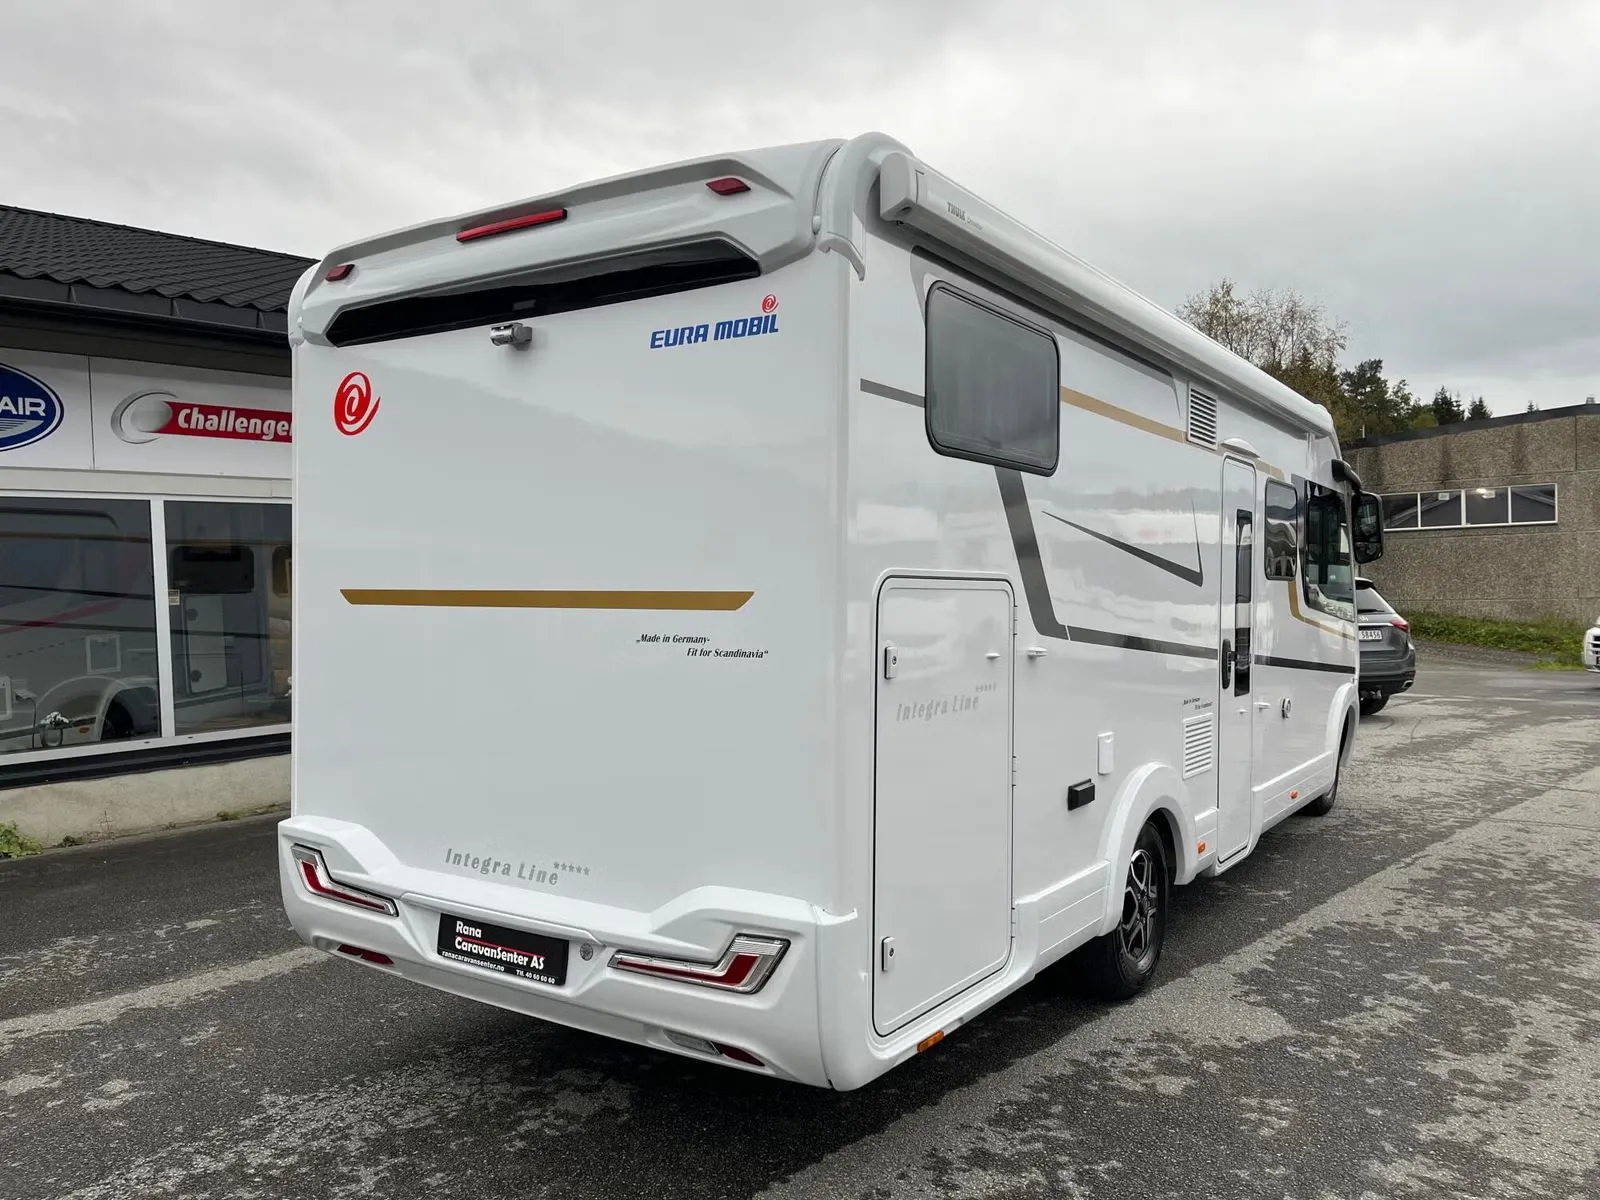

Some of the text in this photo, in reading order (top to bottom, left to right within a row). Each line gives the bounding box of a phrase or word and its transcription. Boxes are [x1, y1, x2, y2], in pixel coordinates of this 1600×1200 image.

[650, 314, 779, 349] EURA MOBIL
[0, 396, 46, 416] AIR
[662, 634, 671, 643] in
[687, 648, 698, 656] Fit
[699, 648, 712, 657] for
[896, 695, 979, 721] Integra Line
[445, 848, 559, 886] Integra Line
[456, 921, 482, 938] Rana
[442, 951, 504, 972] ranacaravansenter.no
[455, 936, 545, 970] CaravanSenter AS
